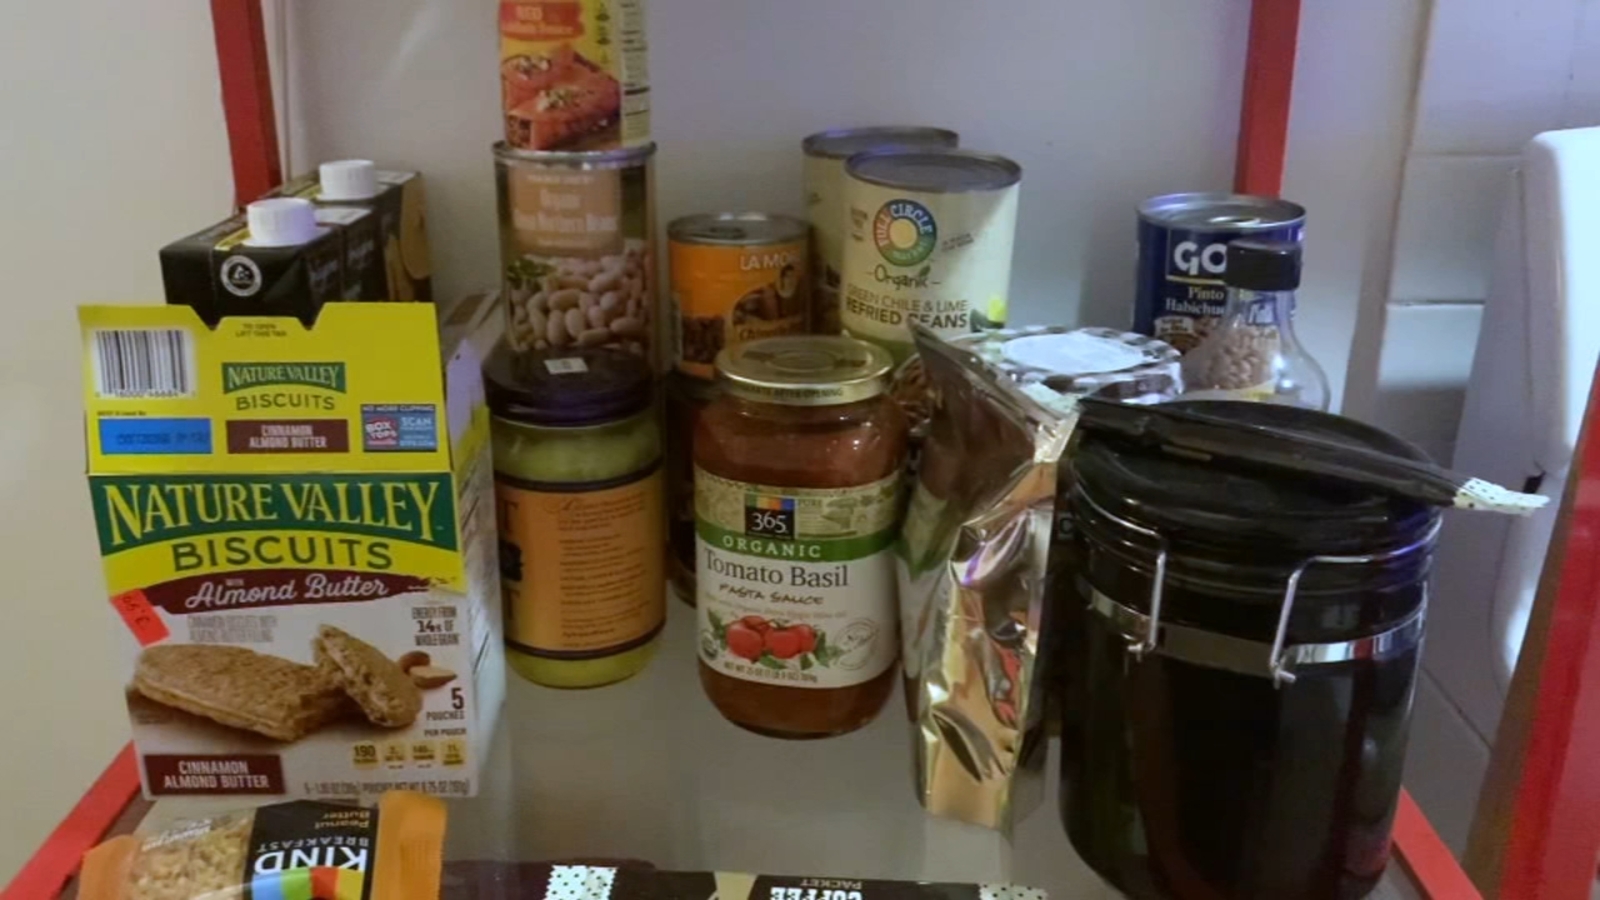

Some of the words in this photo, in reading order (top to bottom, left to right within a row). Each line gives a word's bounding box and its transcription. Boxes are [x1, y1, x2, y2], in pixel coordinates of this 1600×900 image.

[890, 203, 933, 236] CIRCLE
[740, 254, 761, 271] LA
[1173, 241, 1228, 276] GO
[874, 263, 928, 291] Organic
[1187, 286, 1225, 301] Pinto
[880, 294, 921, 311] CHILE
[923, 300, 933, 312] &
[935, 299, 968, 313] LIME
[228, 365, 285, 390] NATURE
[285, 364, 340, 390] VALLEY
[235, 393, 336, 411] BISCUITS
[260, 424, 314, 436] CINNAMON
[364, 420, 391, 434] BOX
[400, 416, 433, 427] SCAN
[248, 436, 290, 449] ALMOND
[290, 436, 328, 449] BUTTER
[370, 429, 399, 440] TOPS
[102, 482, 278, 547] NATURE
[280, 480, 441, 542] VALLEY
[751, 510, 787, 534] 365
[171, 534, 394, 573] BISCUITS
[722, 534, 822, 559] ORGANIC
[704, 548, 784, 586] Tomato
[789, 564, 849, 589] Basil
[184, 580, 297, 610] Almond
[304, 572, 390, 600] Butter
[718, 582, 765, 601] PASTA
[769, 590, 825, 606] SAUCE
[450, 686, 465, 711] 5
[425, 710, 466, 721] POUCHES
[424, 729, 439, 737] PER
[440, 727, 467, 736] POUCH
[353, 744, 376, 758] 190
[178, 759, 249, 775] CINNAMON
[163, 774, 218, 789] ALMOND
[219, 774, 270, 789] BUTTER
[322, 810, 371, 820] Butter
[314, 820, 371, 830] Peanut
[257, 835, 370, 853] BREAKFAST
[253, 845, 368, 875] KIND
[800, 878, 863, 890] PACKET
